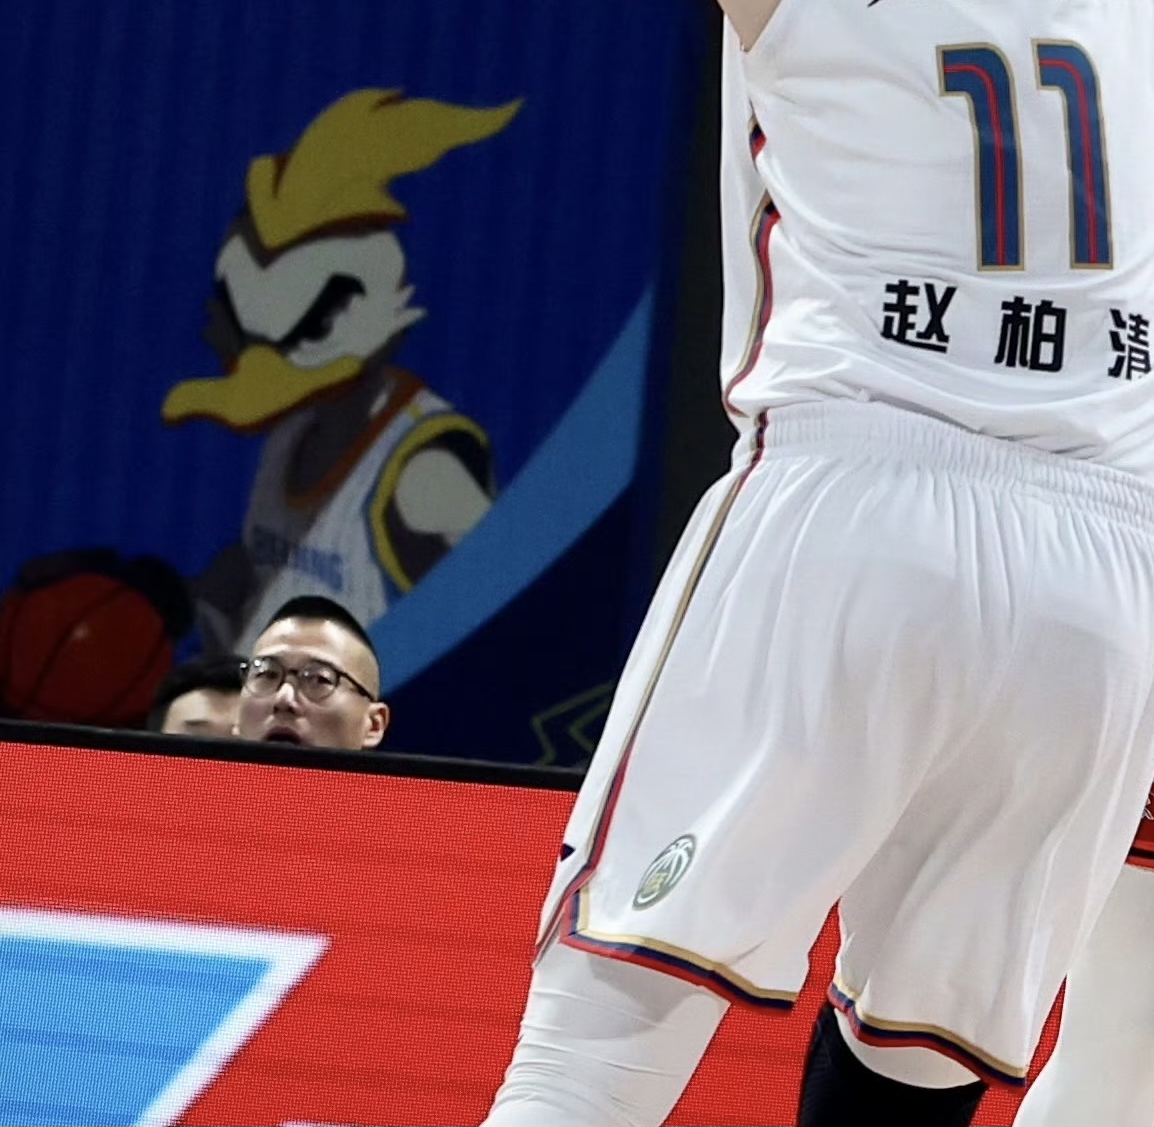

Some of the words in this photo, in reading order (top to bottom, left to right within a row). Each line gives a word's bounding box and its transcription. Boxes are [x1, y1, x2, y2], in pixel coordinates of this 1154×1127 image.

[935, 39, 1114, 272] 11
[881, 279, 1152, 381] 赵柏清
